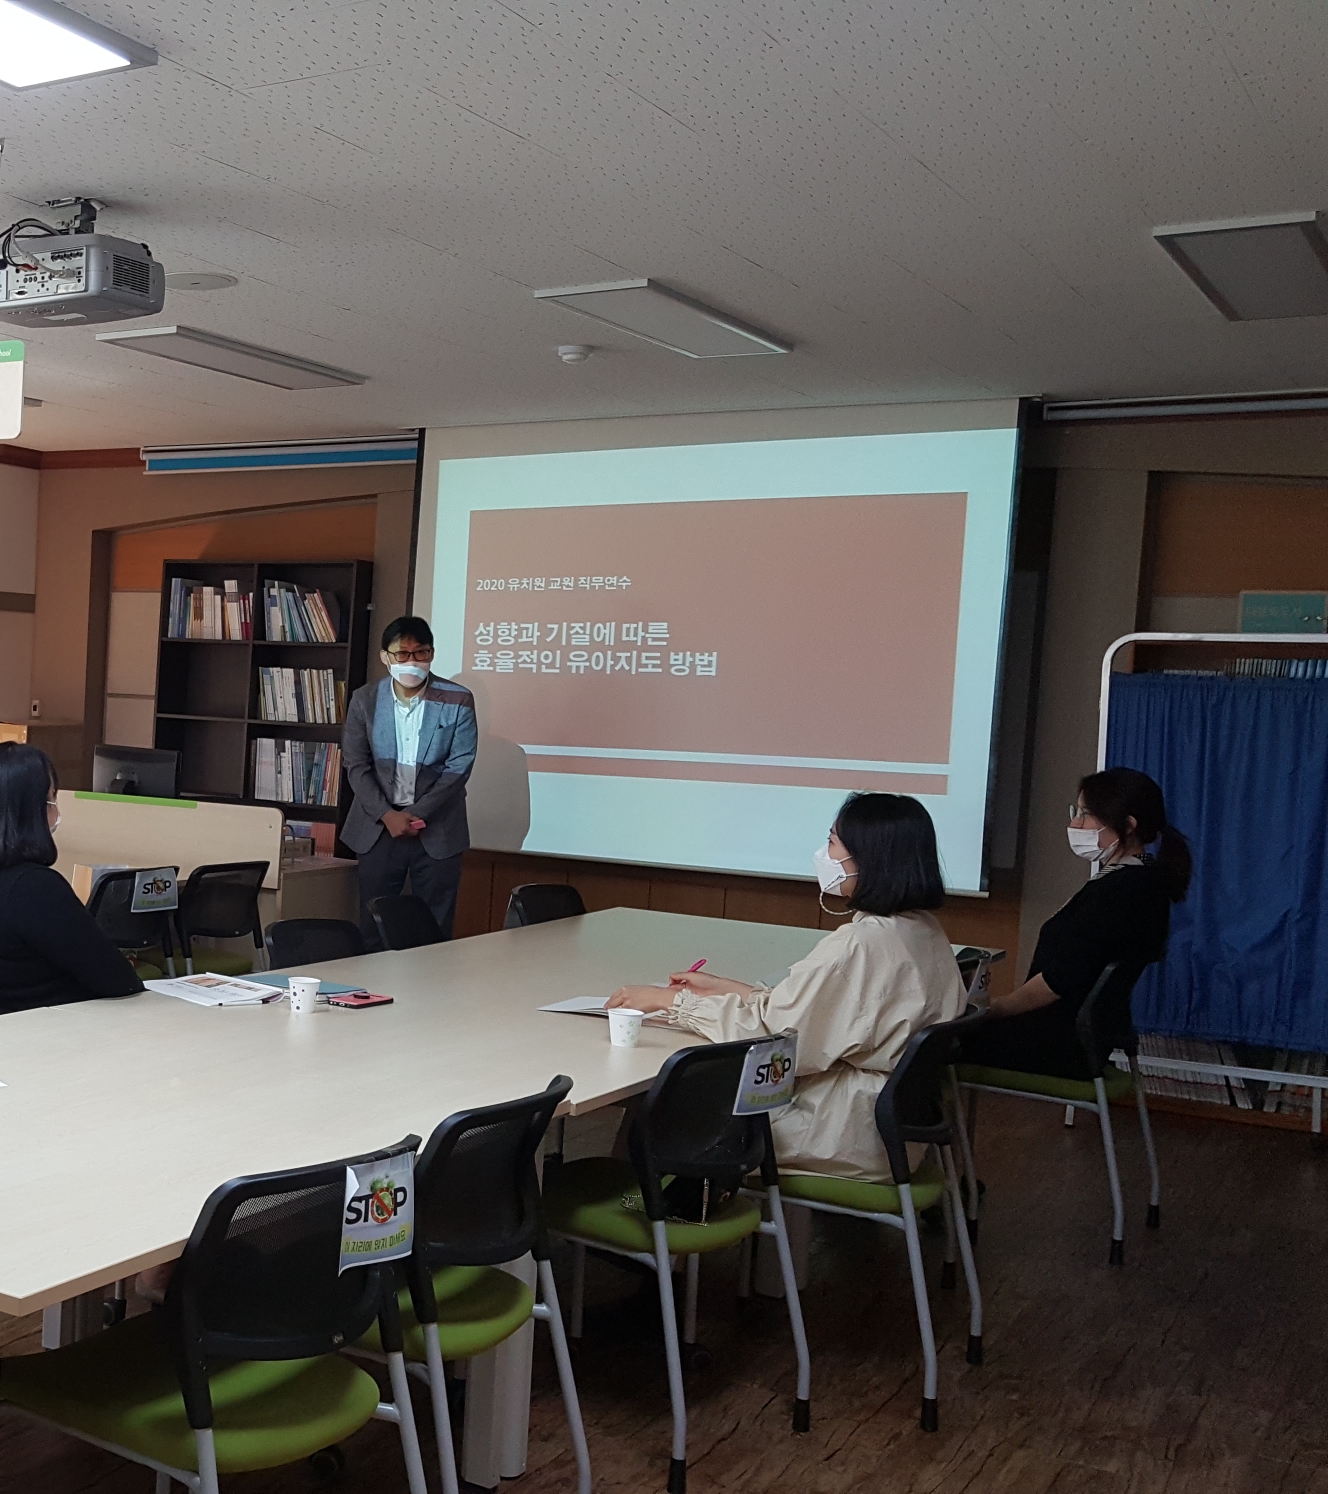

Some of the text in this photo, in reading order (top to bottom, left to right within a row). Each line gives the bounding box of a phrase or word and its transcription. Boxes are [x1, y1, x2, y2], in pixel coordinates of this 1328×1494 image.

[476, 576, 632, 591] 2020 유치원 교원 직무연수
[474, 621, 669, 645] 성향과 기질에 따른
[472, 650, 718, 676] 효율적인 유아지도 방법
[142, 880, 171, 894] STOP
[754, 1058, 791, 1085] STOP
[345, 1186, 407, 1225] STOP
